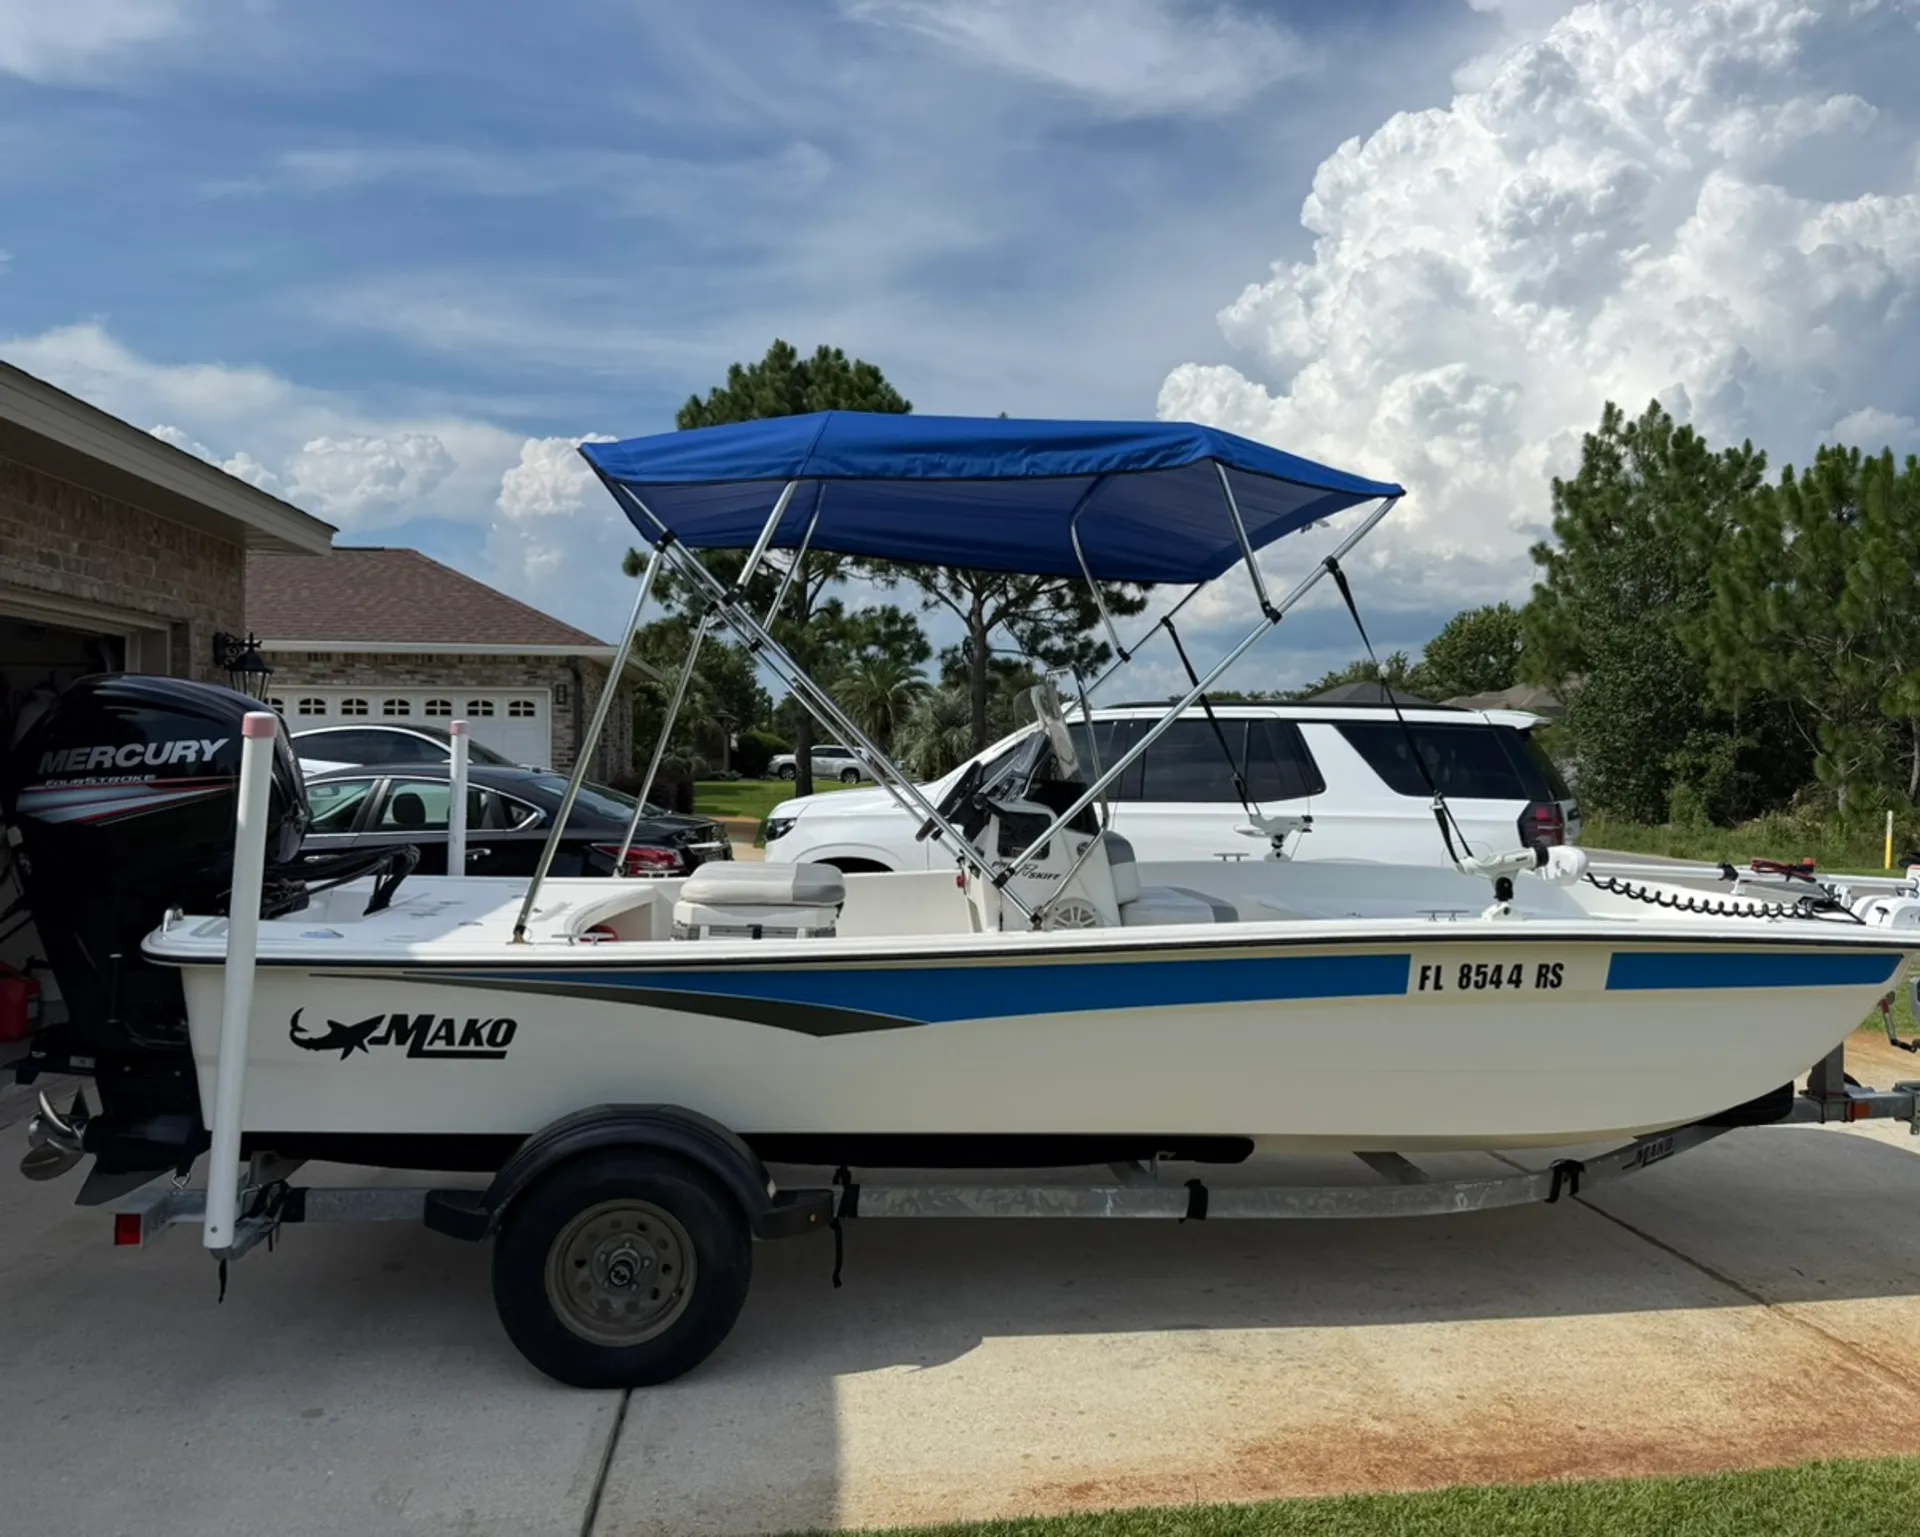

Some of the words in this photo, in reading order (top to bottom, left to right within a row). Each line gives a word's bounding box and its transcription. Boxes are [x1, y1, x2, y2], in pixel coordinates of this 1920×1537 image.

[37, 737, 230, 775] MERCURY
[1028, 872, 1062, 881] SKIFF
[1418, 965, 1444, 991] FL
[1457, 963, 1524, 990] 8544
[1534, 962, 1565, 989] RS
[366, 1013, 518, 1060] MAKO
